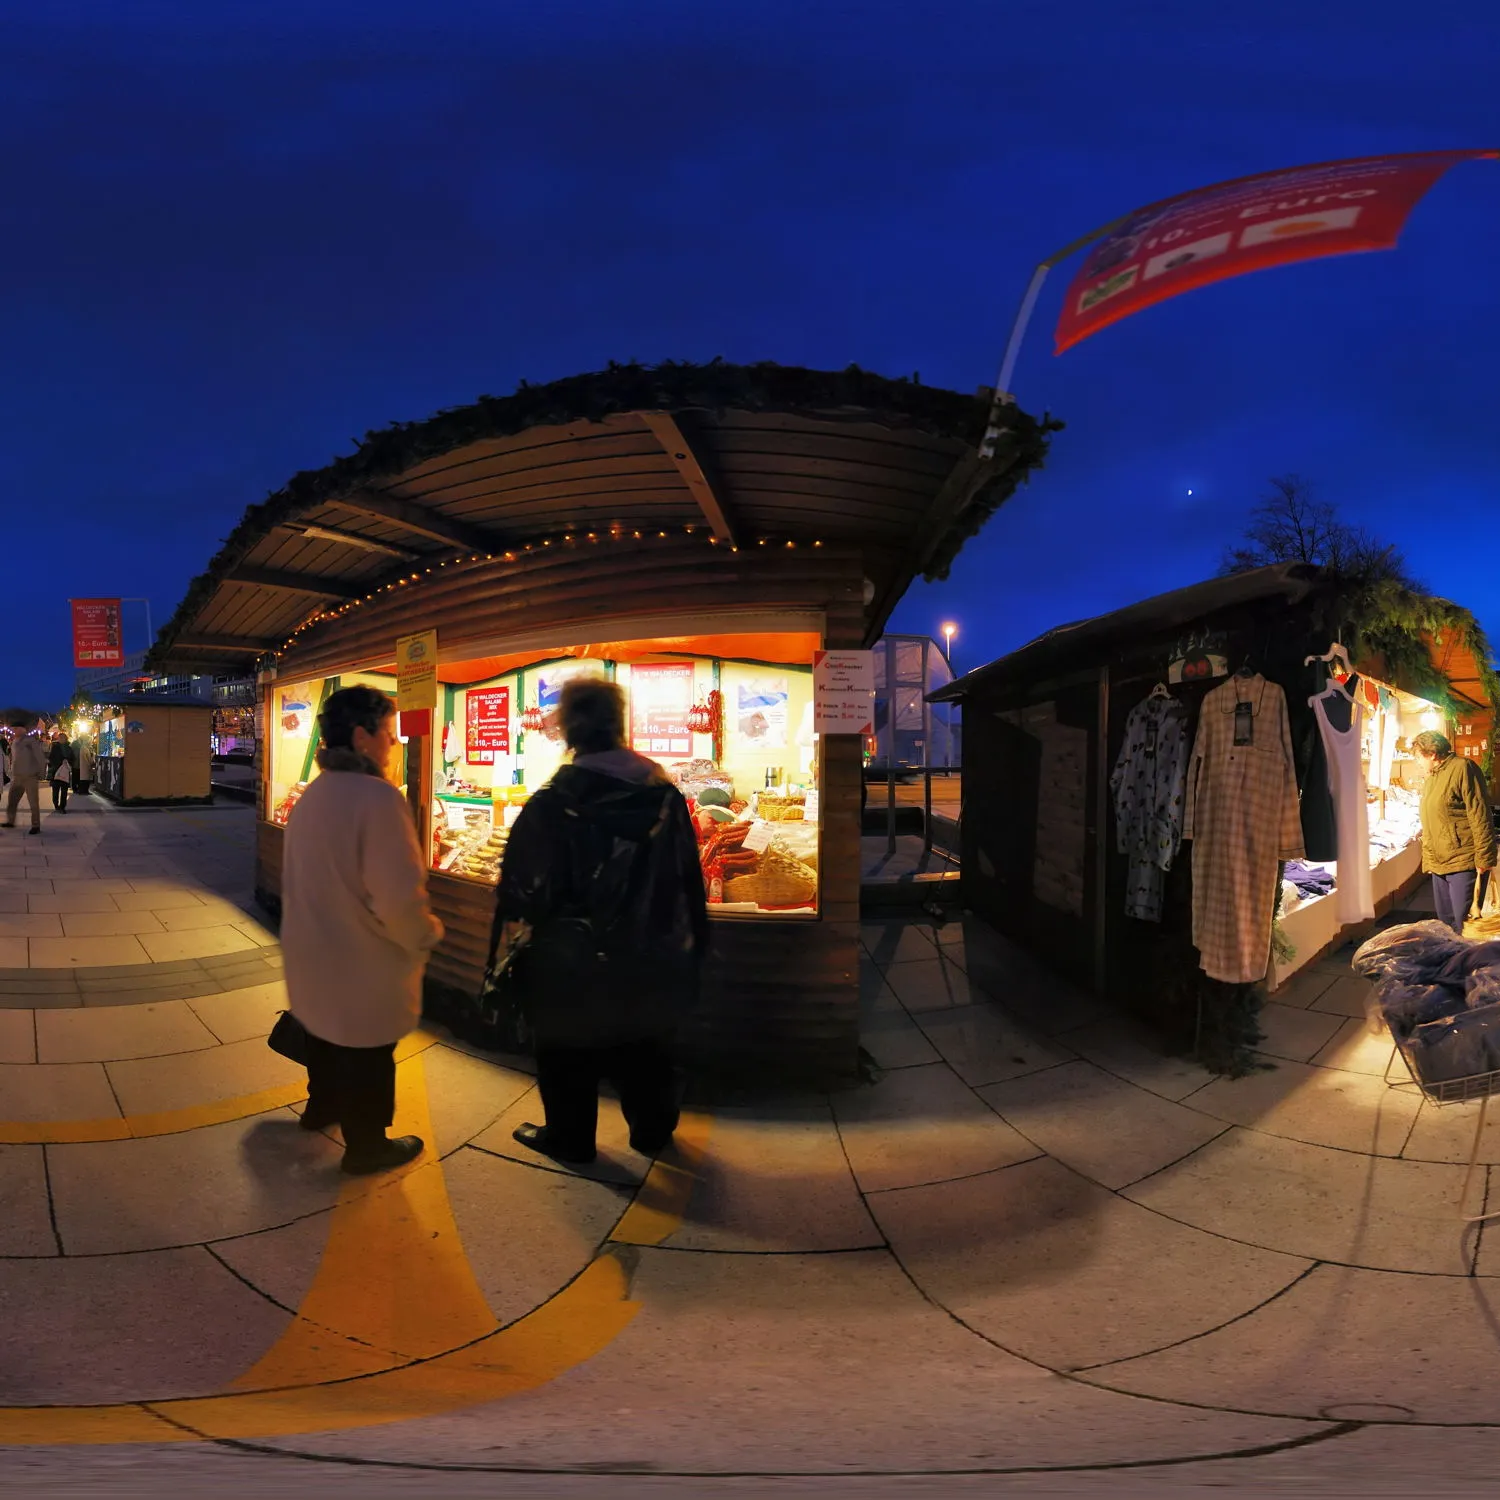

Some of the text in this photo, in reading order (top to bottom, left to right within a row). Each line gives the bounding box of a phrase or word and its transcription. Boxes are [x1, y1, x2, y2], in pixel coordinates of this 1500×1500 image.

[1238, 189, 1378, 218] Euro
[668, 725, 689, 734] Euro
[492, 739, 507, 747] Euro
